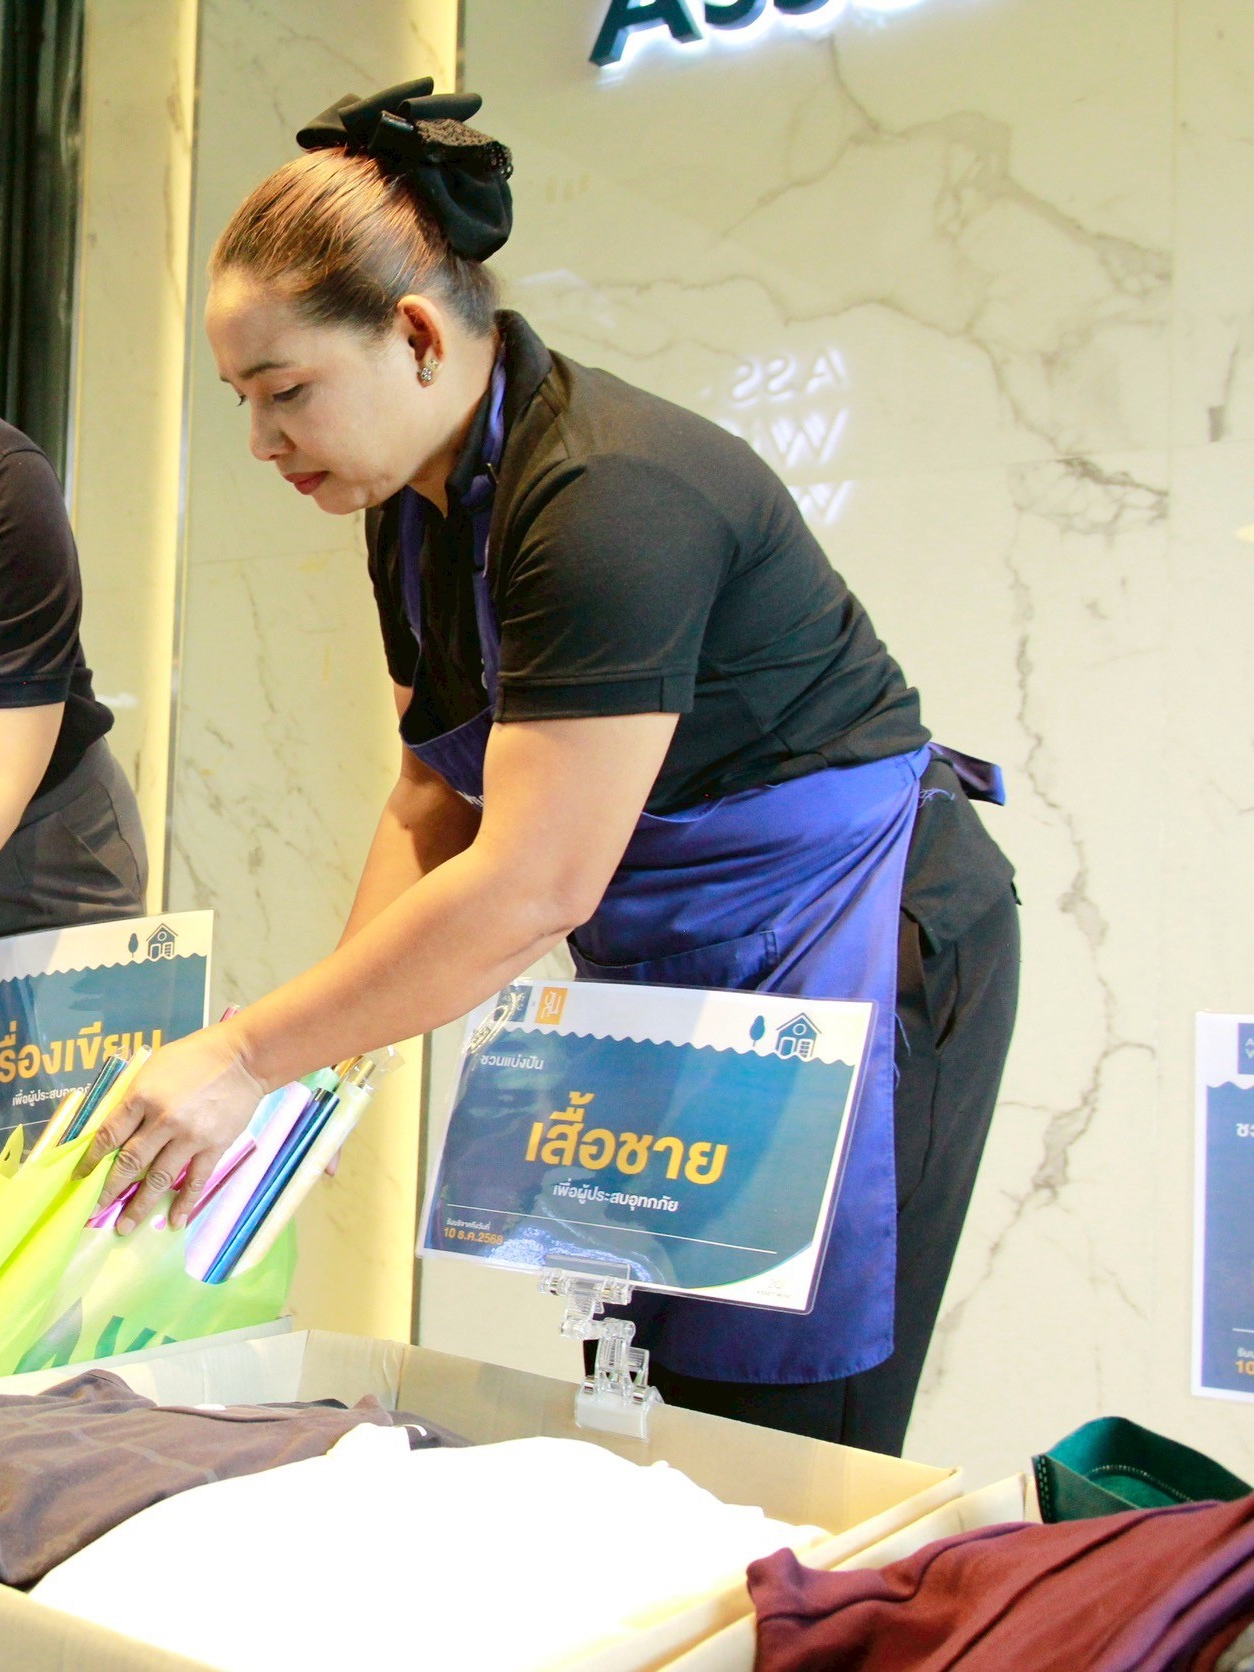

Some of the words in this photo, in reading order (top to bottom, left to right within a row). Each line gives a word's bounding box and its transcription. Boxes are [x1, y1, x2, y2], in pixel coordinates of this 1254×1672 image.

[480, 1052, 544, 1071] ชวนแบ่งปัน
[524, 1091, 728, 1185] เสื้อชาย
[553, 1178, 678, 1214] เพื่อผู้ประสบอุทกภัย
[444, 1227, 456, 1239] 10
